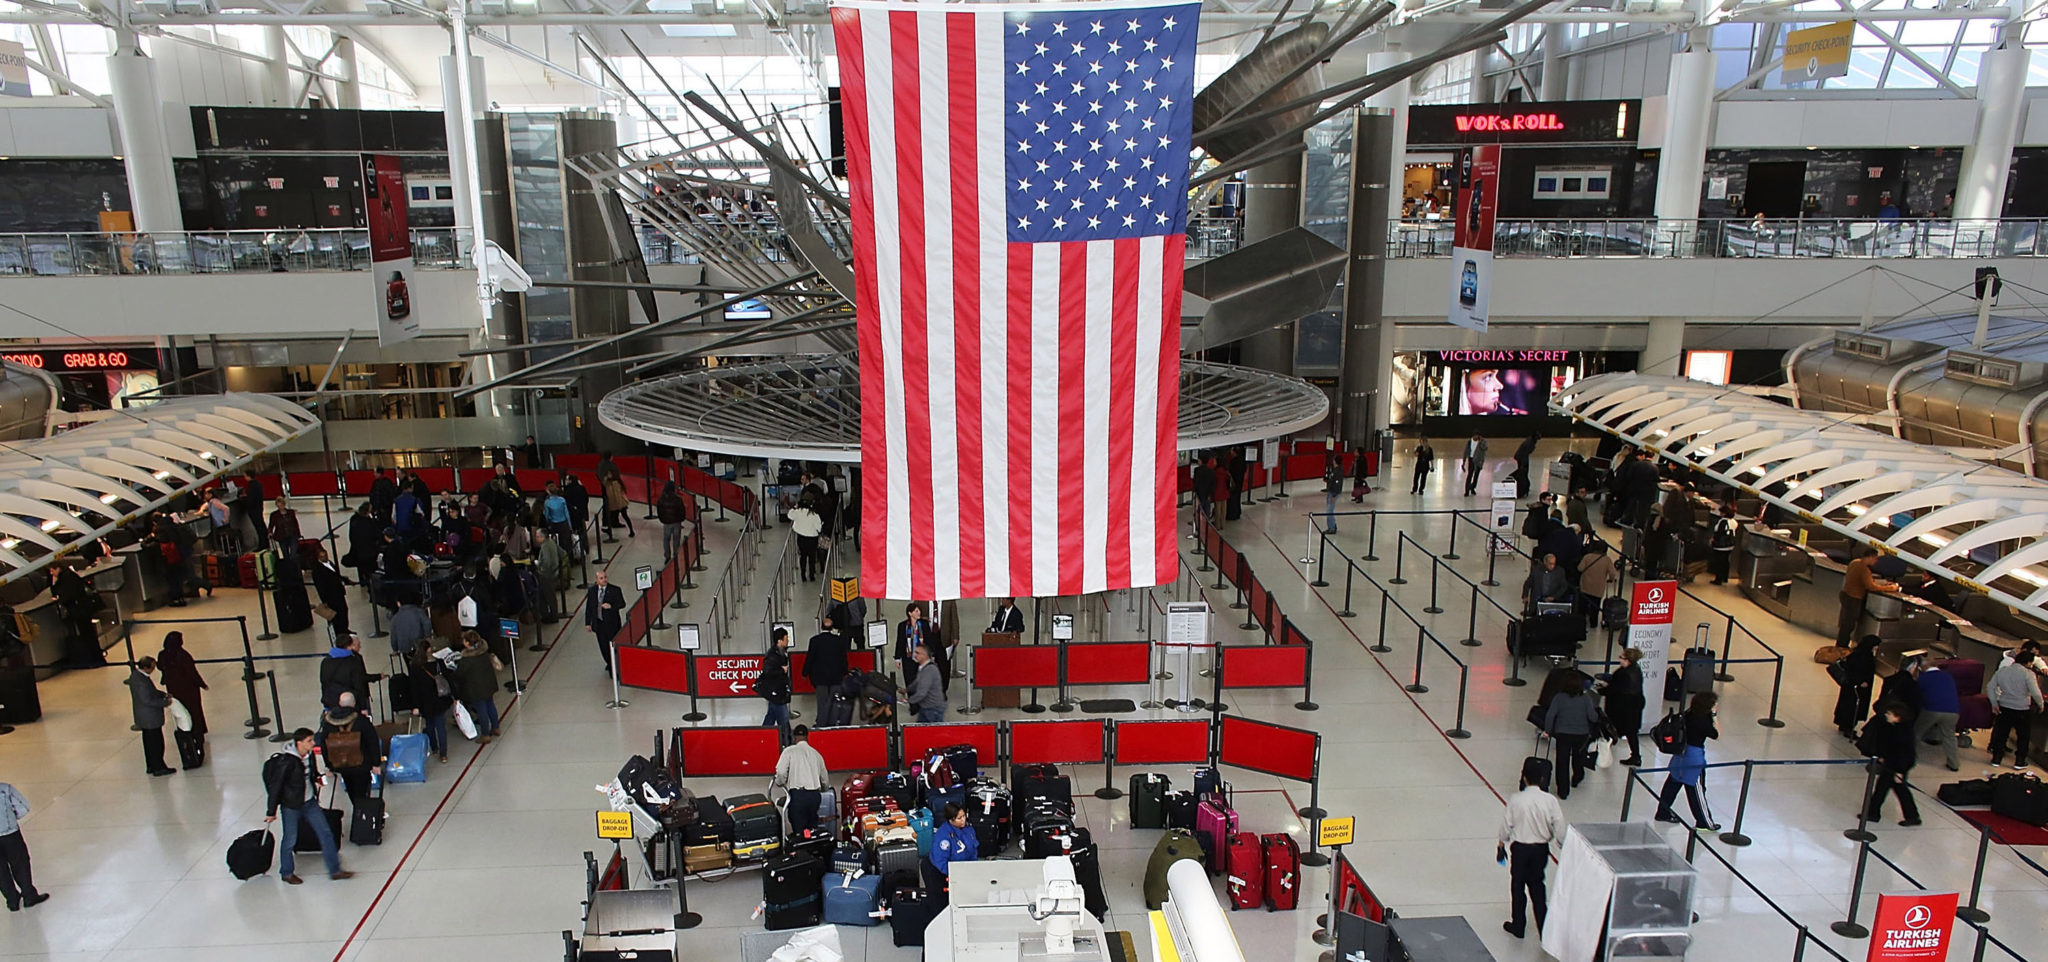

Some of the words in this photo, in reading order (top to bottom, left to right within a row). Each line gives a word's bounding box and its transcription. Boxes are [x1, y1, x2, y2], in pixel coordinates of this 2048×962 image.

[1786, 42, 1811, 55] SECURITY
[64, 353, 97, 367] GRAB
[98, 353, 107, 366] &
[108, 352, 127, 366] GO
[1440, 350, 1514, 361] VICTORIA'S
[1519, 350, 1568, 361] SECRET
[1634, 630, 1663, 639] ECONOMY
[716, 659, 760, 669] SECURITY
[709, 670, 739, 680] CHECK
[741, 670, 763, 679] POIN
[1323, 824, 1349, 832] BAGGAGE
[1886, 929, 1941, 939] TURKISH
[1883, 938, 1939, 948] AIRLINES
